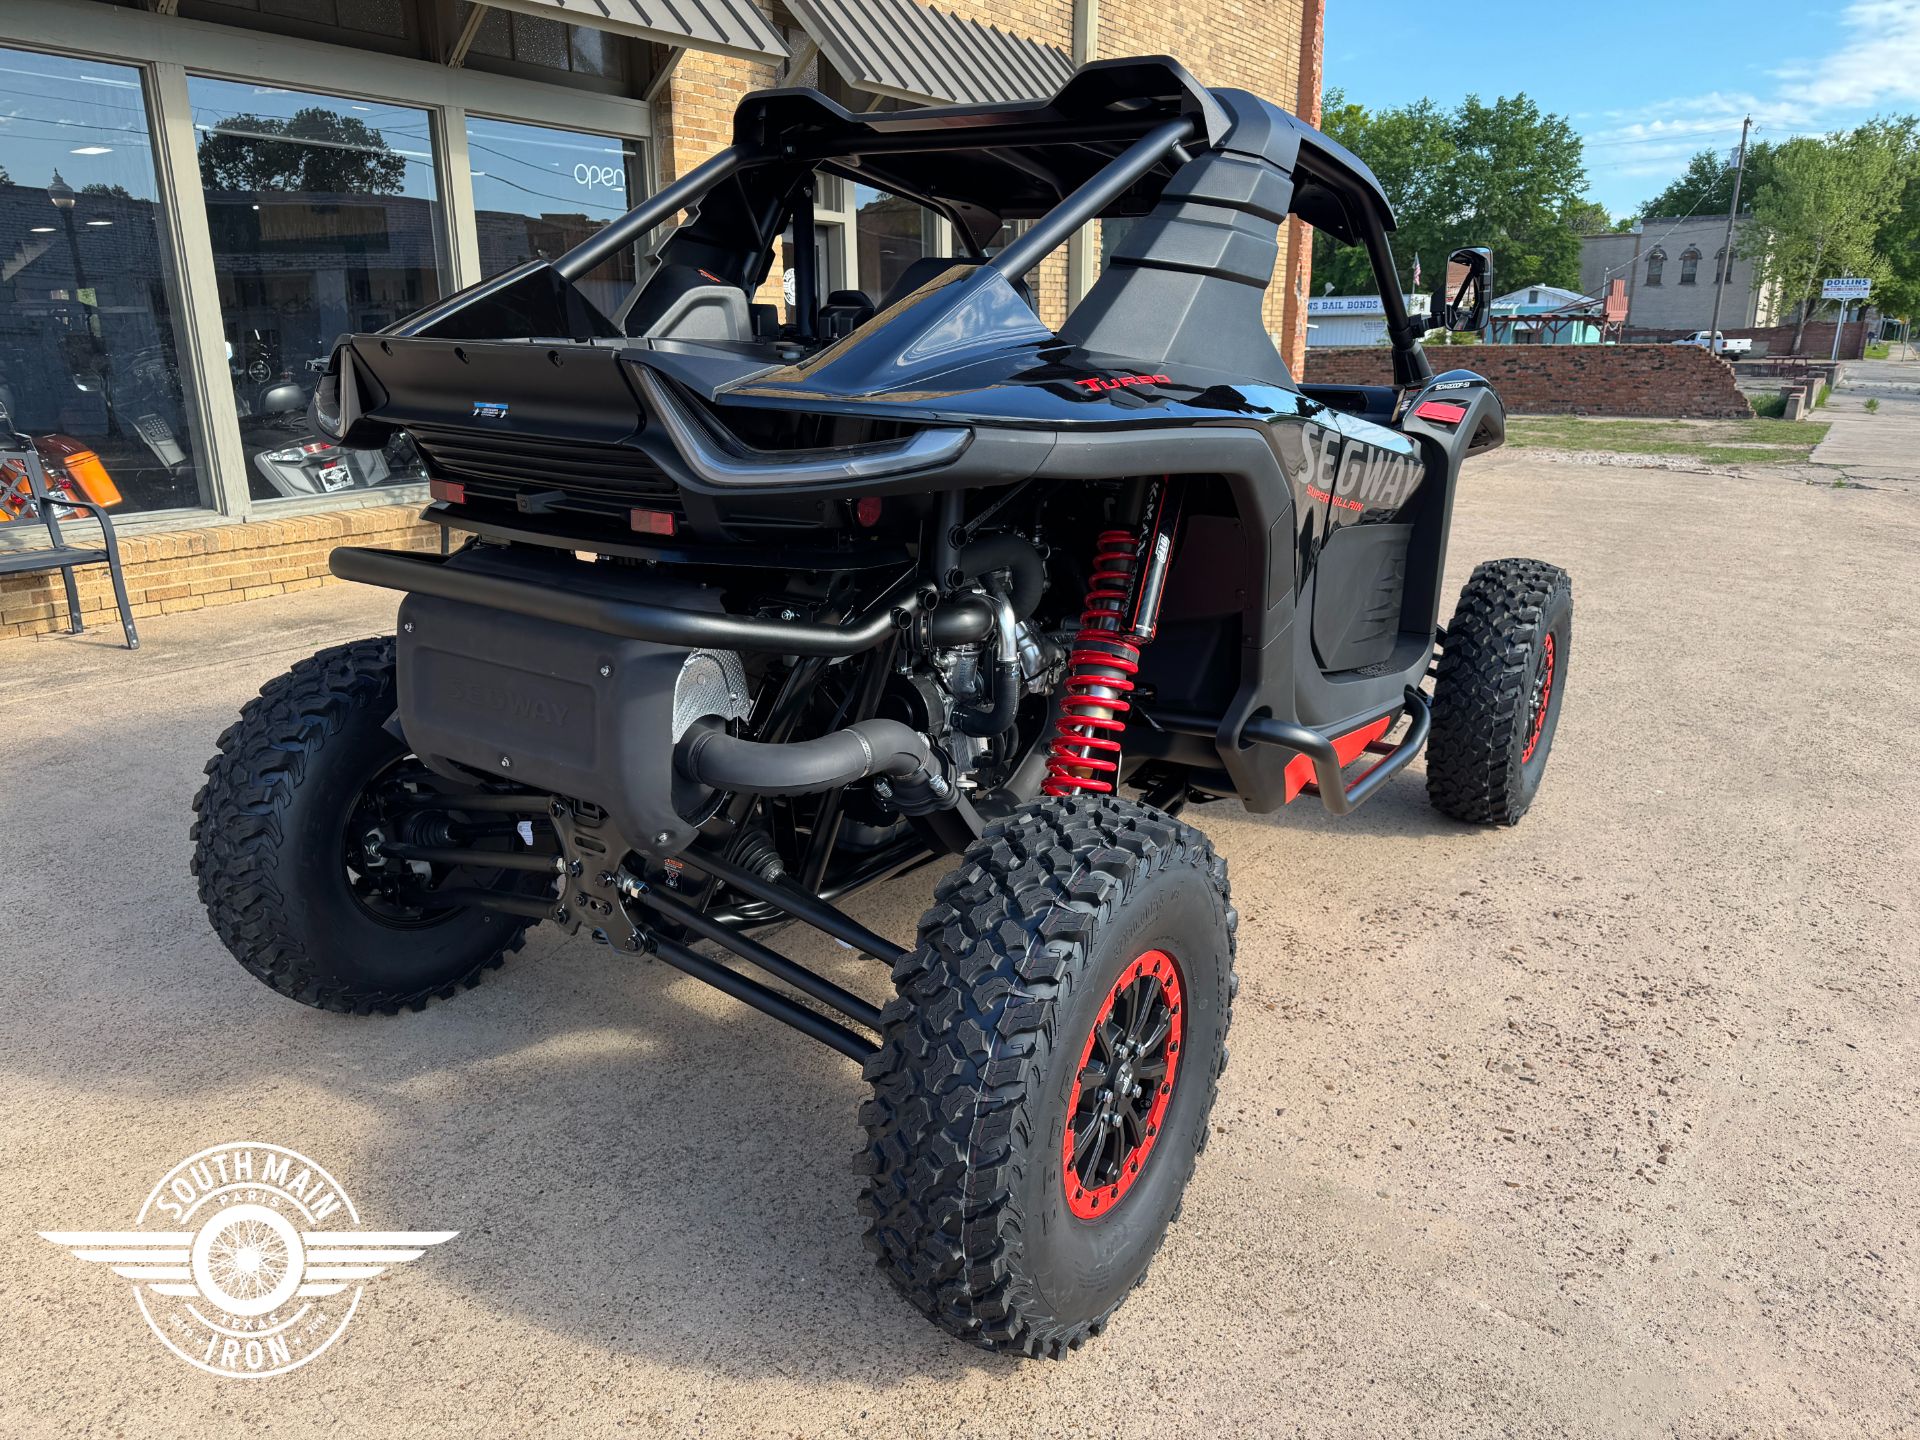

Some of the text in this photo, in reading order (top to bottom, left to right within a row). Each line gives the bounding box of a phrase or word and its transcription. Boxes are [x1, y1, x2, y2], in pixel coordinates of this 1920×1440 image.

[574, 163, 625, 190] open
[1322, 301, 1345, 310] BAIL
[1347, 300, 1378, 309] BONDS
[1298, 421, 1424, 507] SEGWAY
[1306, 483, 1365, 512] SUPER VILLAIN
